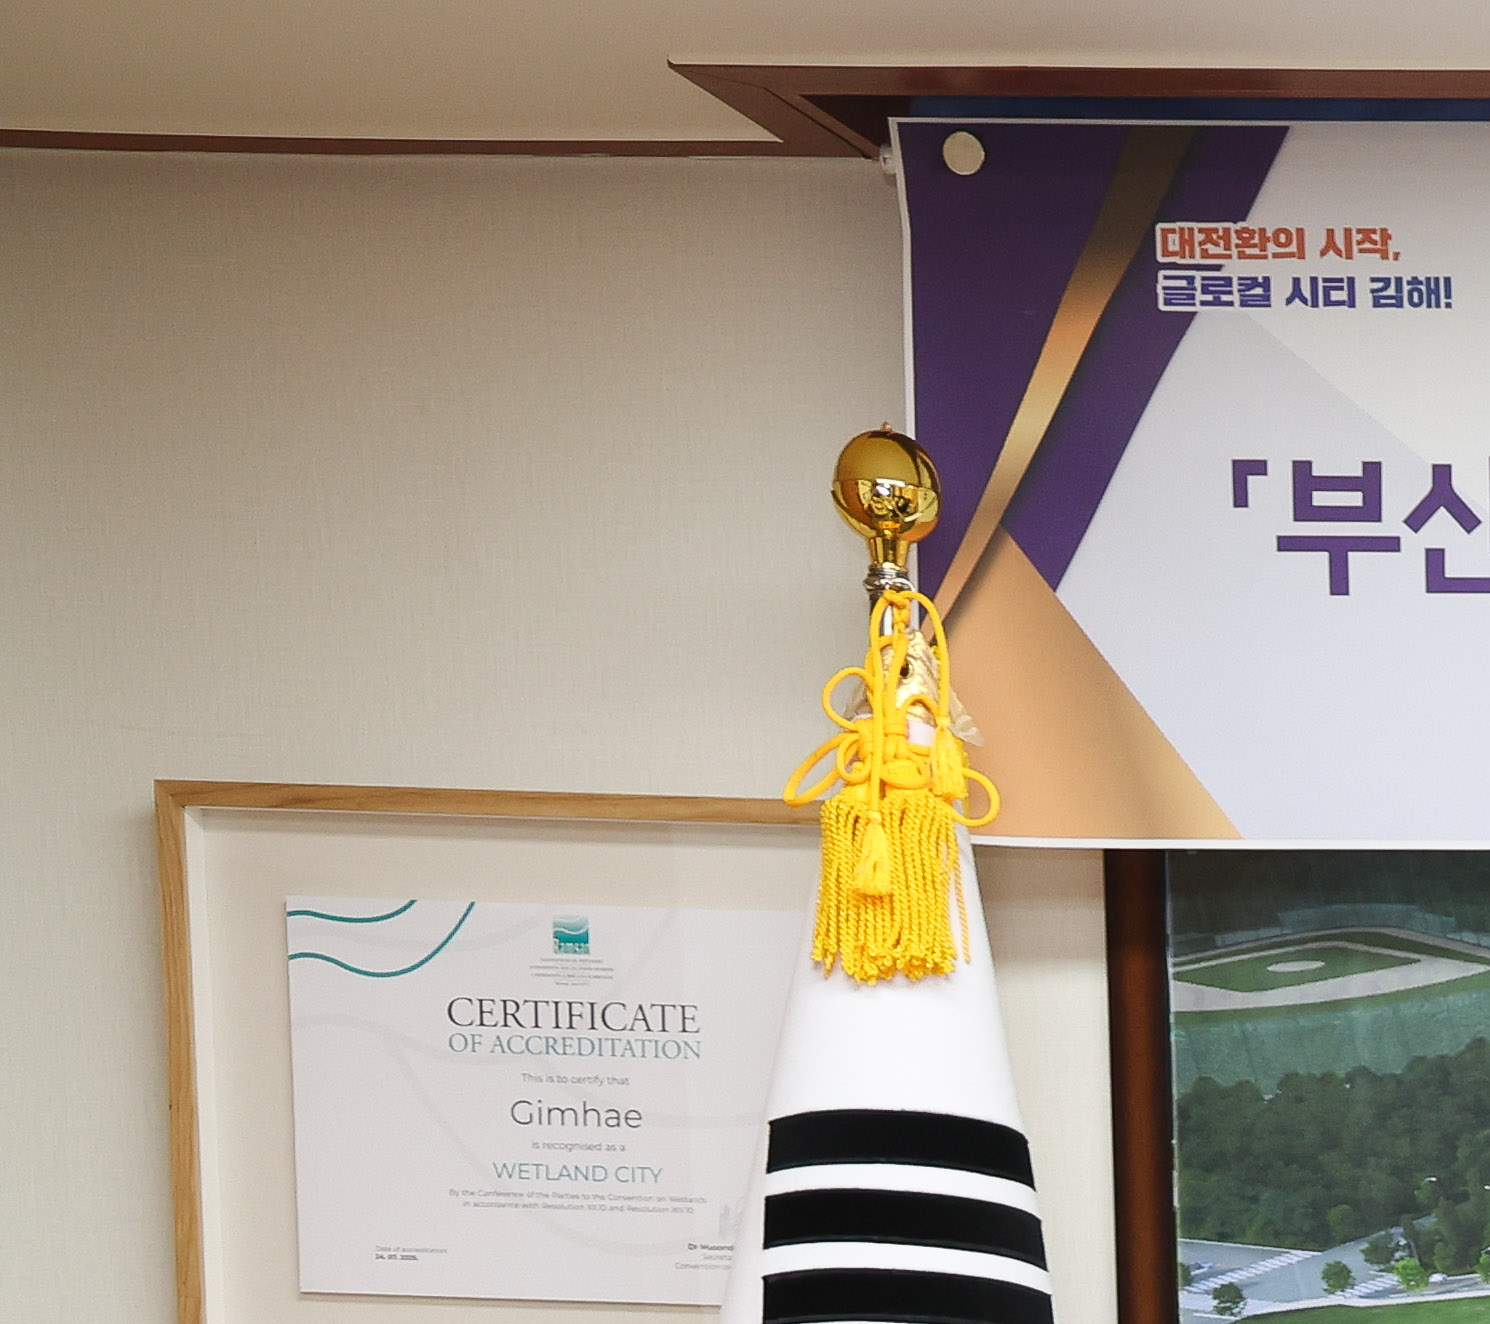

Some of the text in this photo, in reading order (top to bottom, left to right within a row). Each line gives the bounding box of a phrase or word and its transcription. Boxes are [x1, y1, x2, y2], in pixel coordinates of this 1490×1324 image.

[1160, 227, 1401, 261] 대전환의 시작,
[1161, 274, 1453, 309] 글로컬 시티 김해!
[447, 996, 701, 1034] CERTIFICATE
[448, 1033, 702, 1061] OF ACCREDITATION
[521, 1073, 543, 1083] This
[510, 1099, 643, 1129] Gimhae
[532, 1141, 540, 1150] is
[542, 1141, 602, 1153] recognised
[493, 1161, 663, 1184] WETLAND CITY
